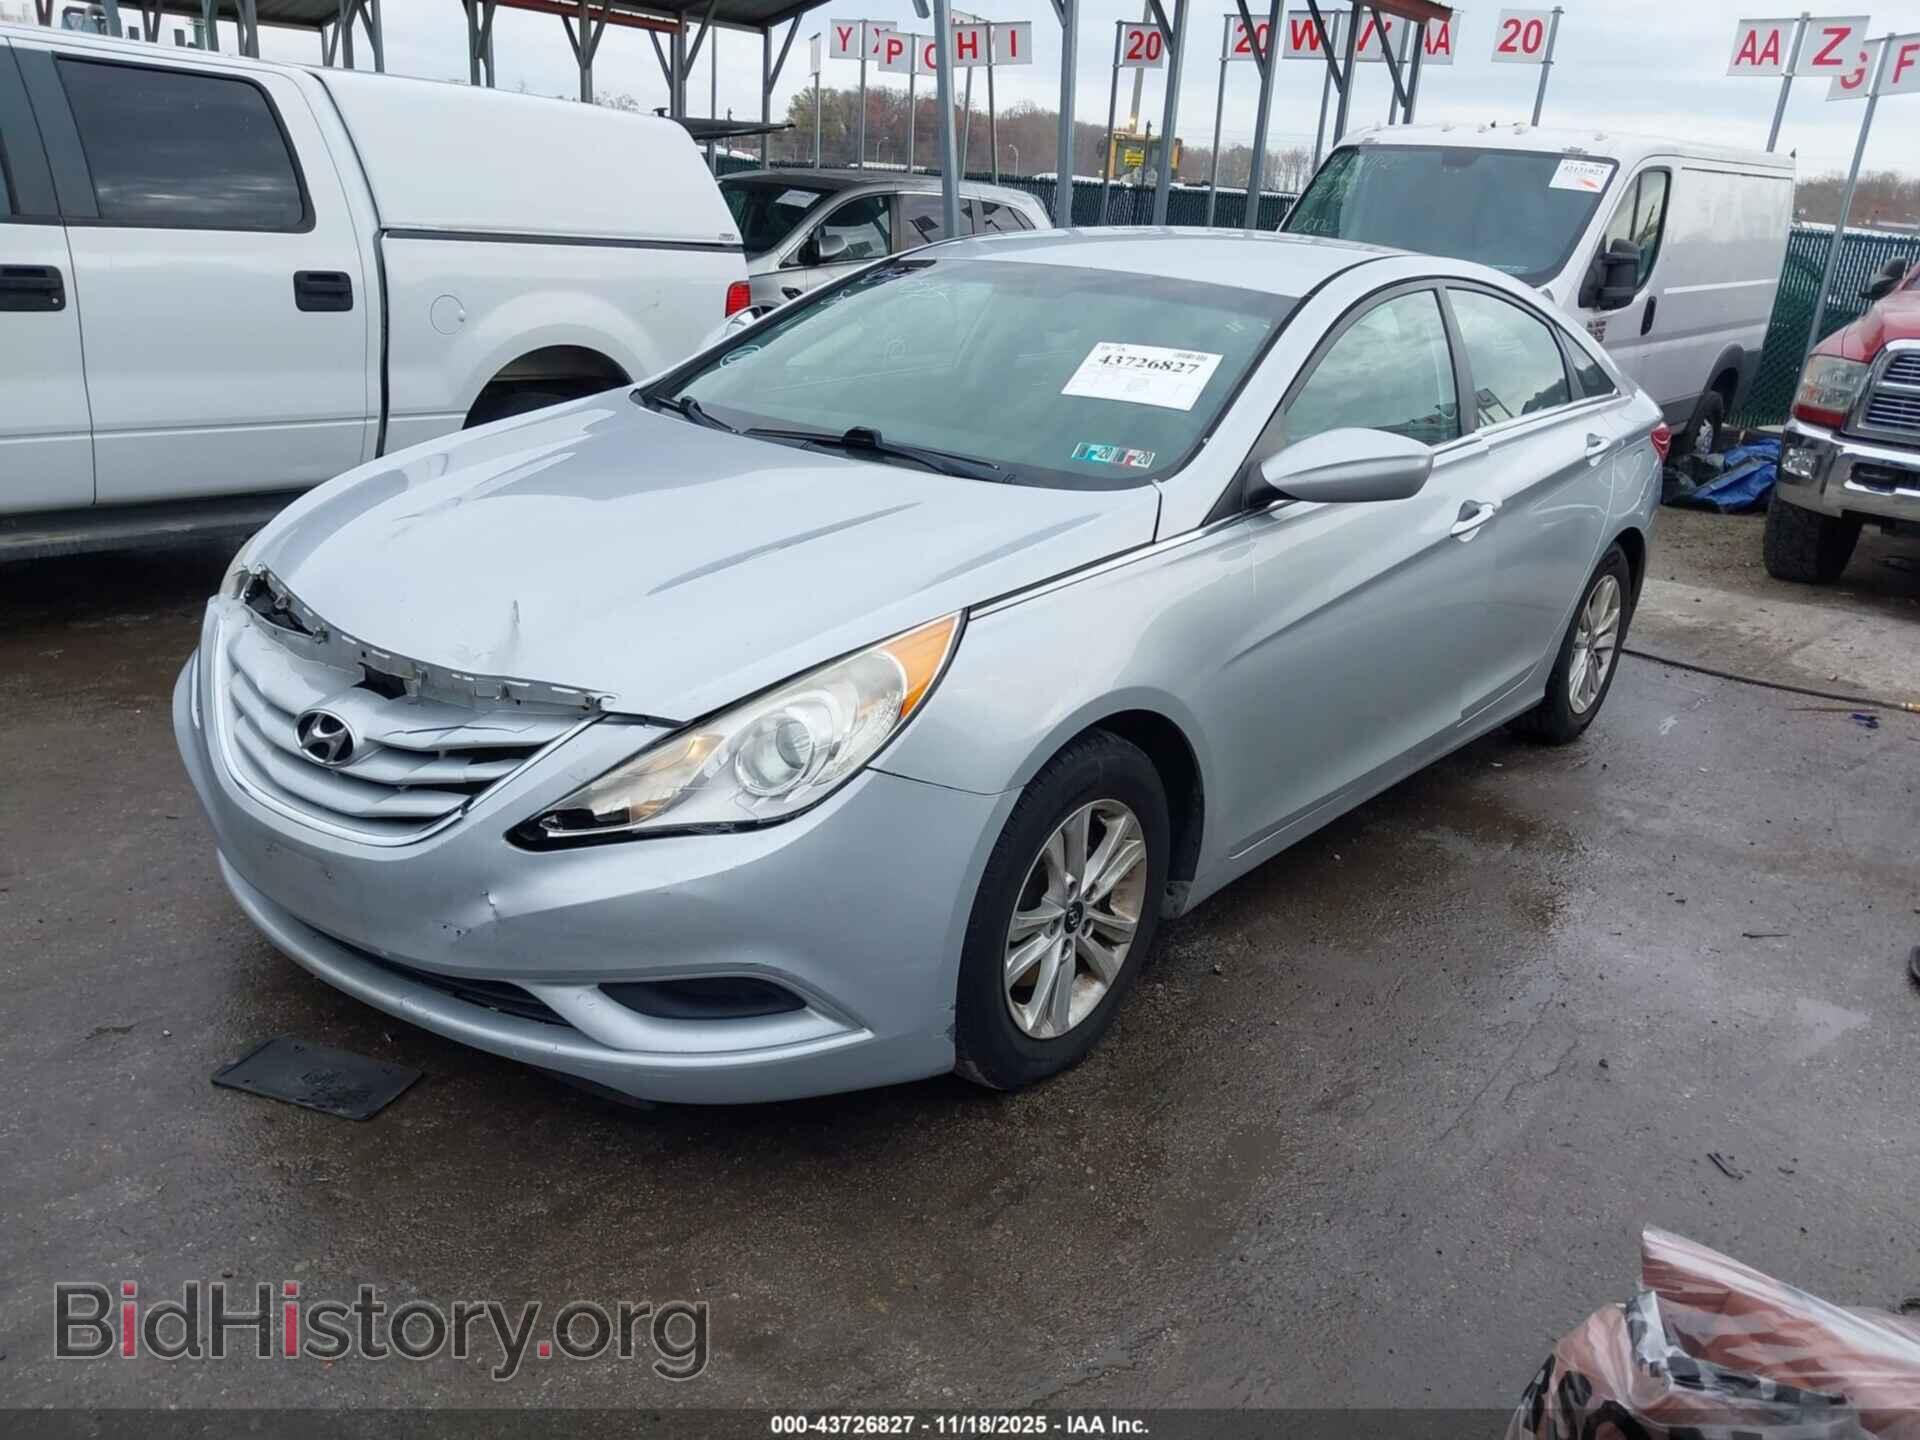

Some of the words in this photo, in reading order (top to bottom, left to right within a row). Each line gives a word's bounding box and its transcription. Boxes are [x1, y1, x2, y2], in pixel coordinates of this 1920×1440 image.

[837, 27, 853, 52] Y
[957, 31, 977, 60] H
[1010, 30, 1017, 57] I
[1127, 31, 1162, 61] 20
[1235, 23, 1270, 55] 20
[1291, 19, 1326, 51] W
[1498, 18, 1543, 54] 20
[1734, 29, 1780, 66] AA
[1812, 27, 1852, 66] Z
[886, 38, 903, 64] P
[1892, 44, 1920, 84] F
[1098, 354, 1201, 375] 43726827
